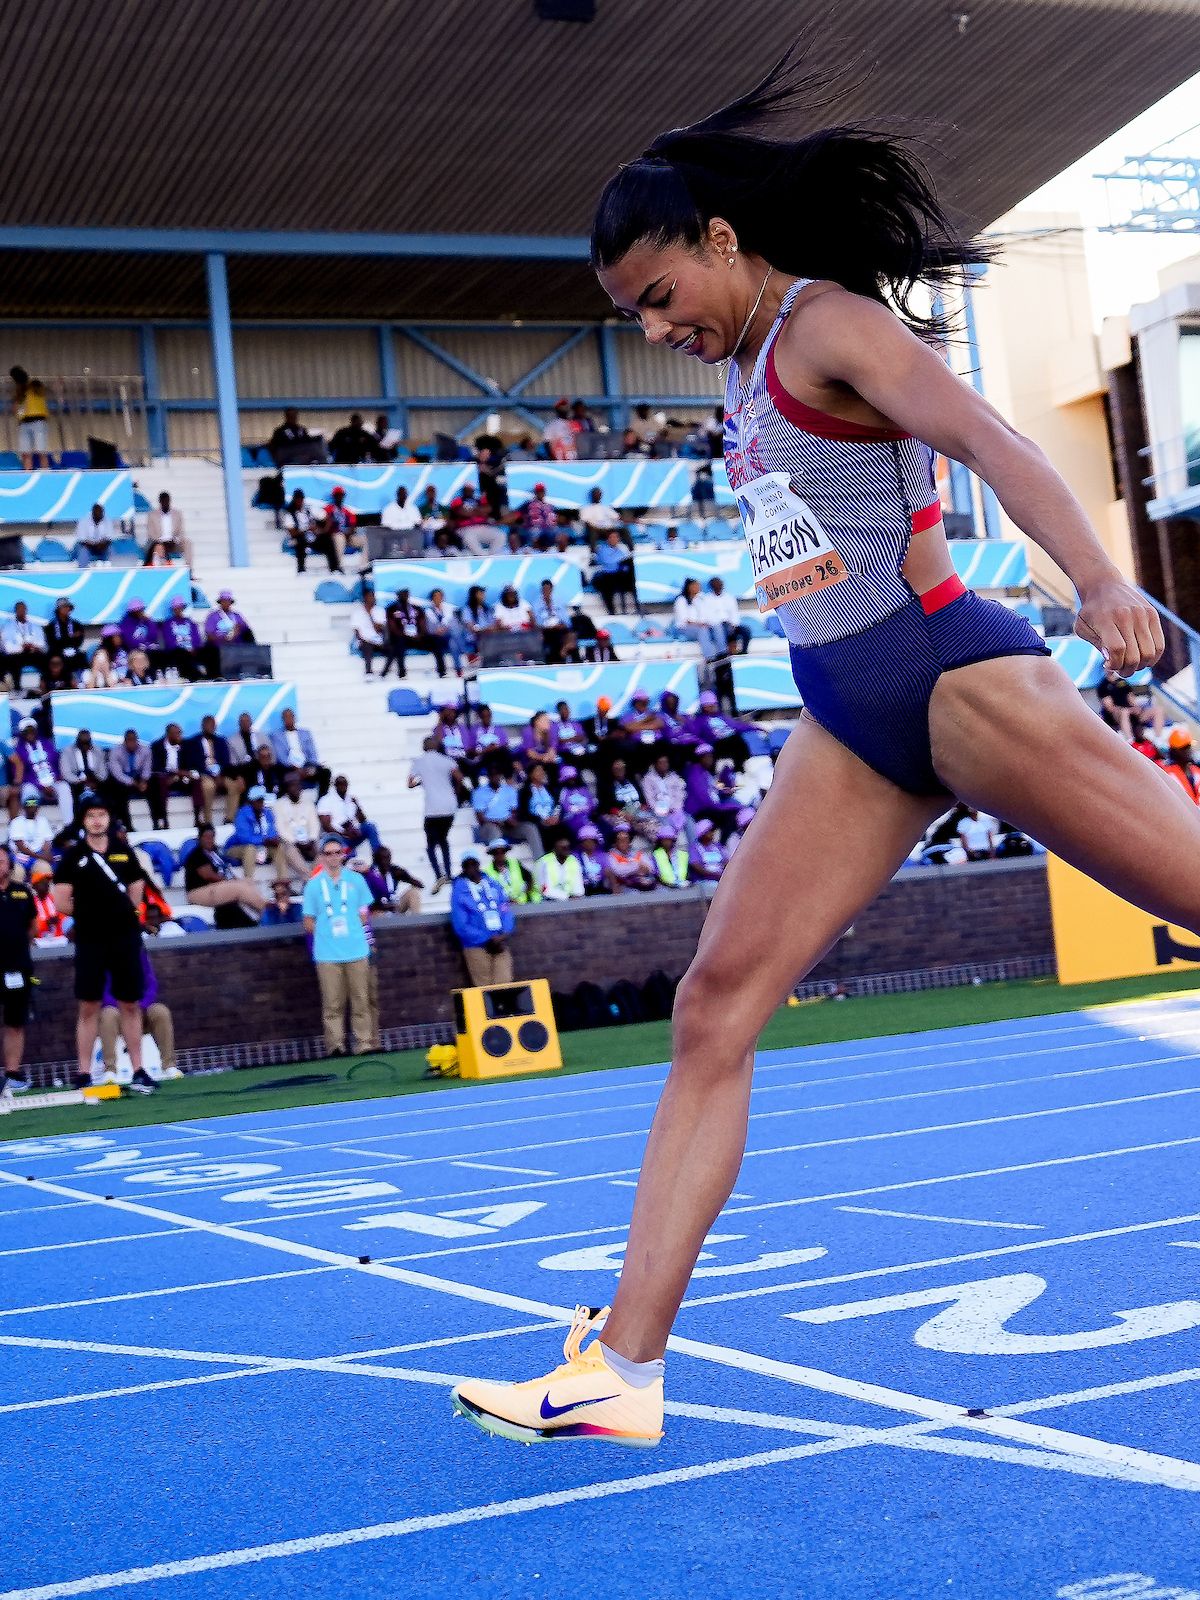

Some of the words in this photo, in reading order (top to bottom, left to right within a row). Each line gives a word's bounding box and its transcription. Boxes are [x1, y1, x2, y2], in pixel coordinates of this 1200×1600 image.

[74, 1150, 202, 1171] 7
[221, 1178, 402, 1208] 5
[341, 1201, 547, 1239] 4
